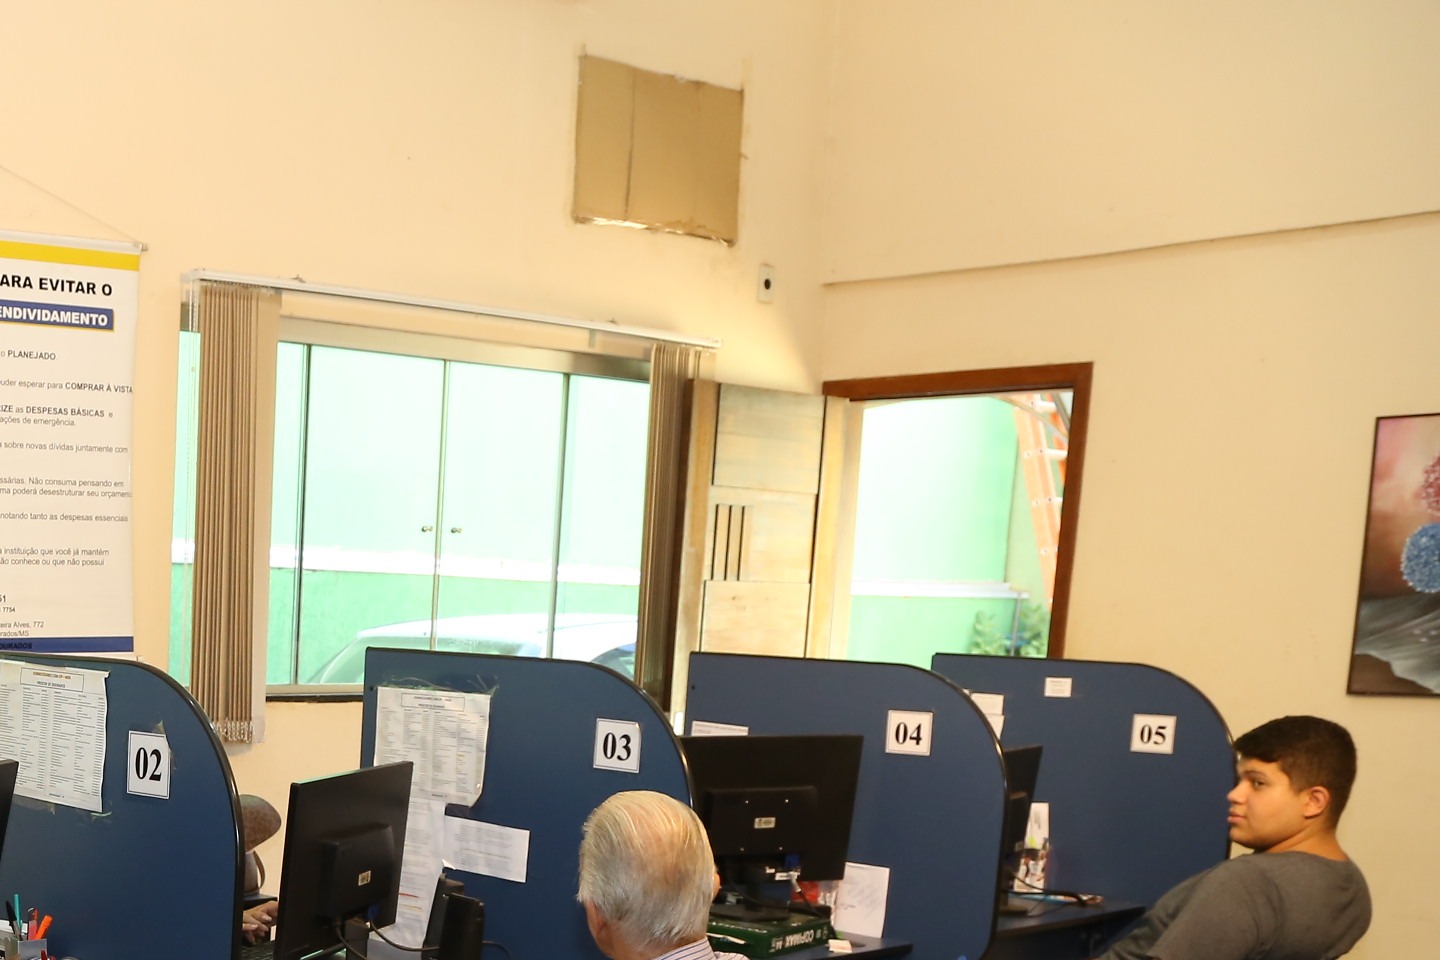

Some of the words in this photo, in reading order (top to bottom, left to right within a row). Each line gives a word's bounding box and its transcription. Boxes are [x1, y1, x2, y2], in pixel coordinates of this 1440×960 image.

[38, 277, 96, 294] EVITAR
[101, 283, 112, 296] O
[18, 380, 44, 388] esperar
[47, 382, 62, 390] para
[65, 381, 104, 391] COMPRAR
[25, 405, 68, 415] DESPESAS
[70, 408, 104, 417] BÁSICAS
[22, 416, 31, 424] de
[4, 440, 24, 449] sobre
[25, 442, 47, 450] novas
[114, 446, 128, 454] com
[28, 476, 43, 485] Não
[44, 478, 76, 486] consuma
[78, 479, 112, 488] pensando
[12, 487, 37, 496] poderá
[38, 488, 85, 496] desestruturar
[29, 512, 47, 520] tanto
[59, 512, 93, 522] despesas
[40, 548, 53, 556] que
[10, 556, 40, 565] conhece
[52, 559, 65, 567] que
[66, 557, 80, 565] não
[81, 558, 104, 567] possui
[33, 620, 44, 628] 772
[895, 721, 922, 746] 04
[1140, 724, 1167, 745] 05
[603, 732, 631, 761] 03
[135, 747, 162, 782] 02
